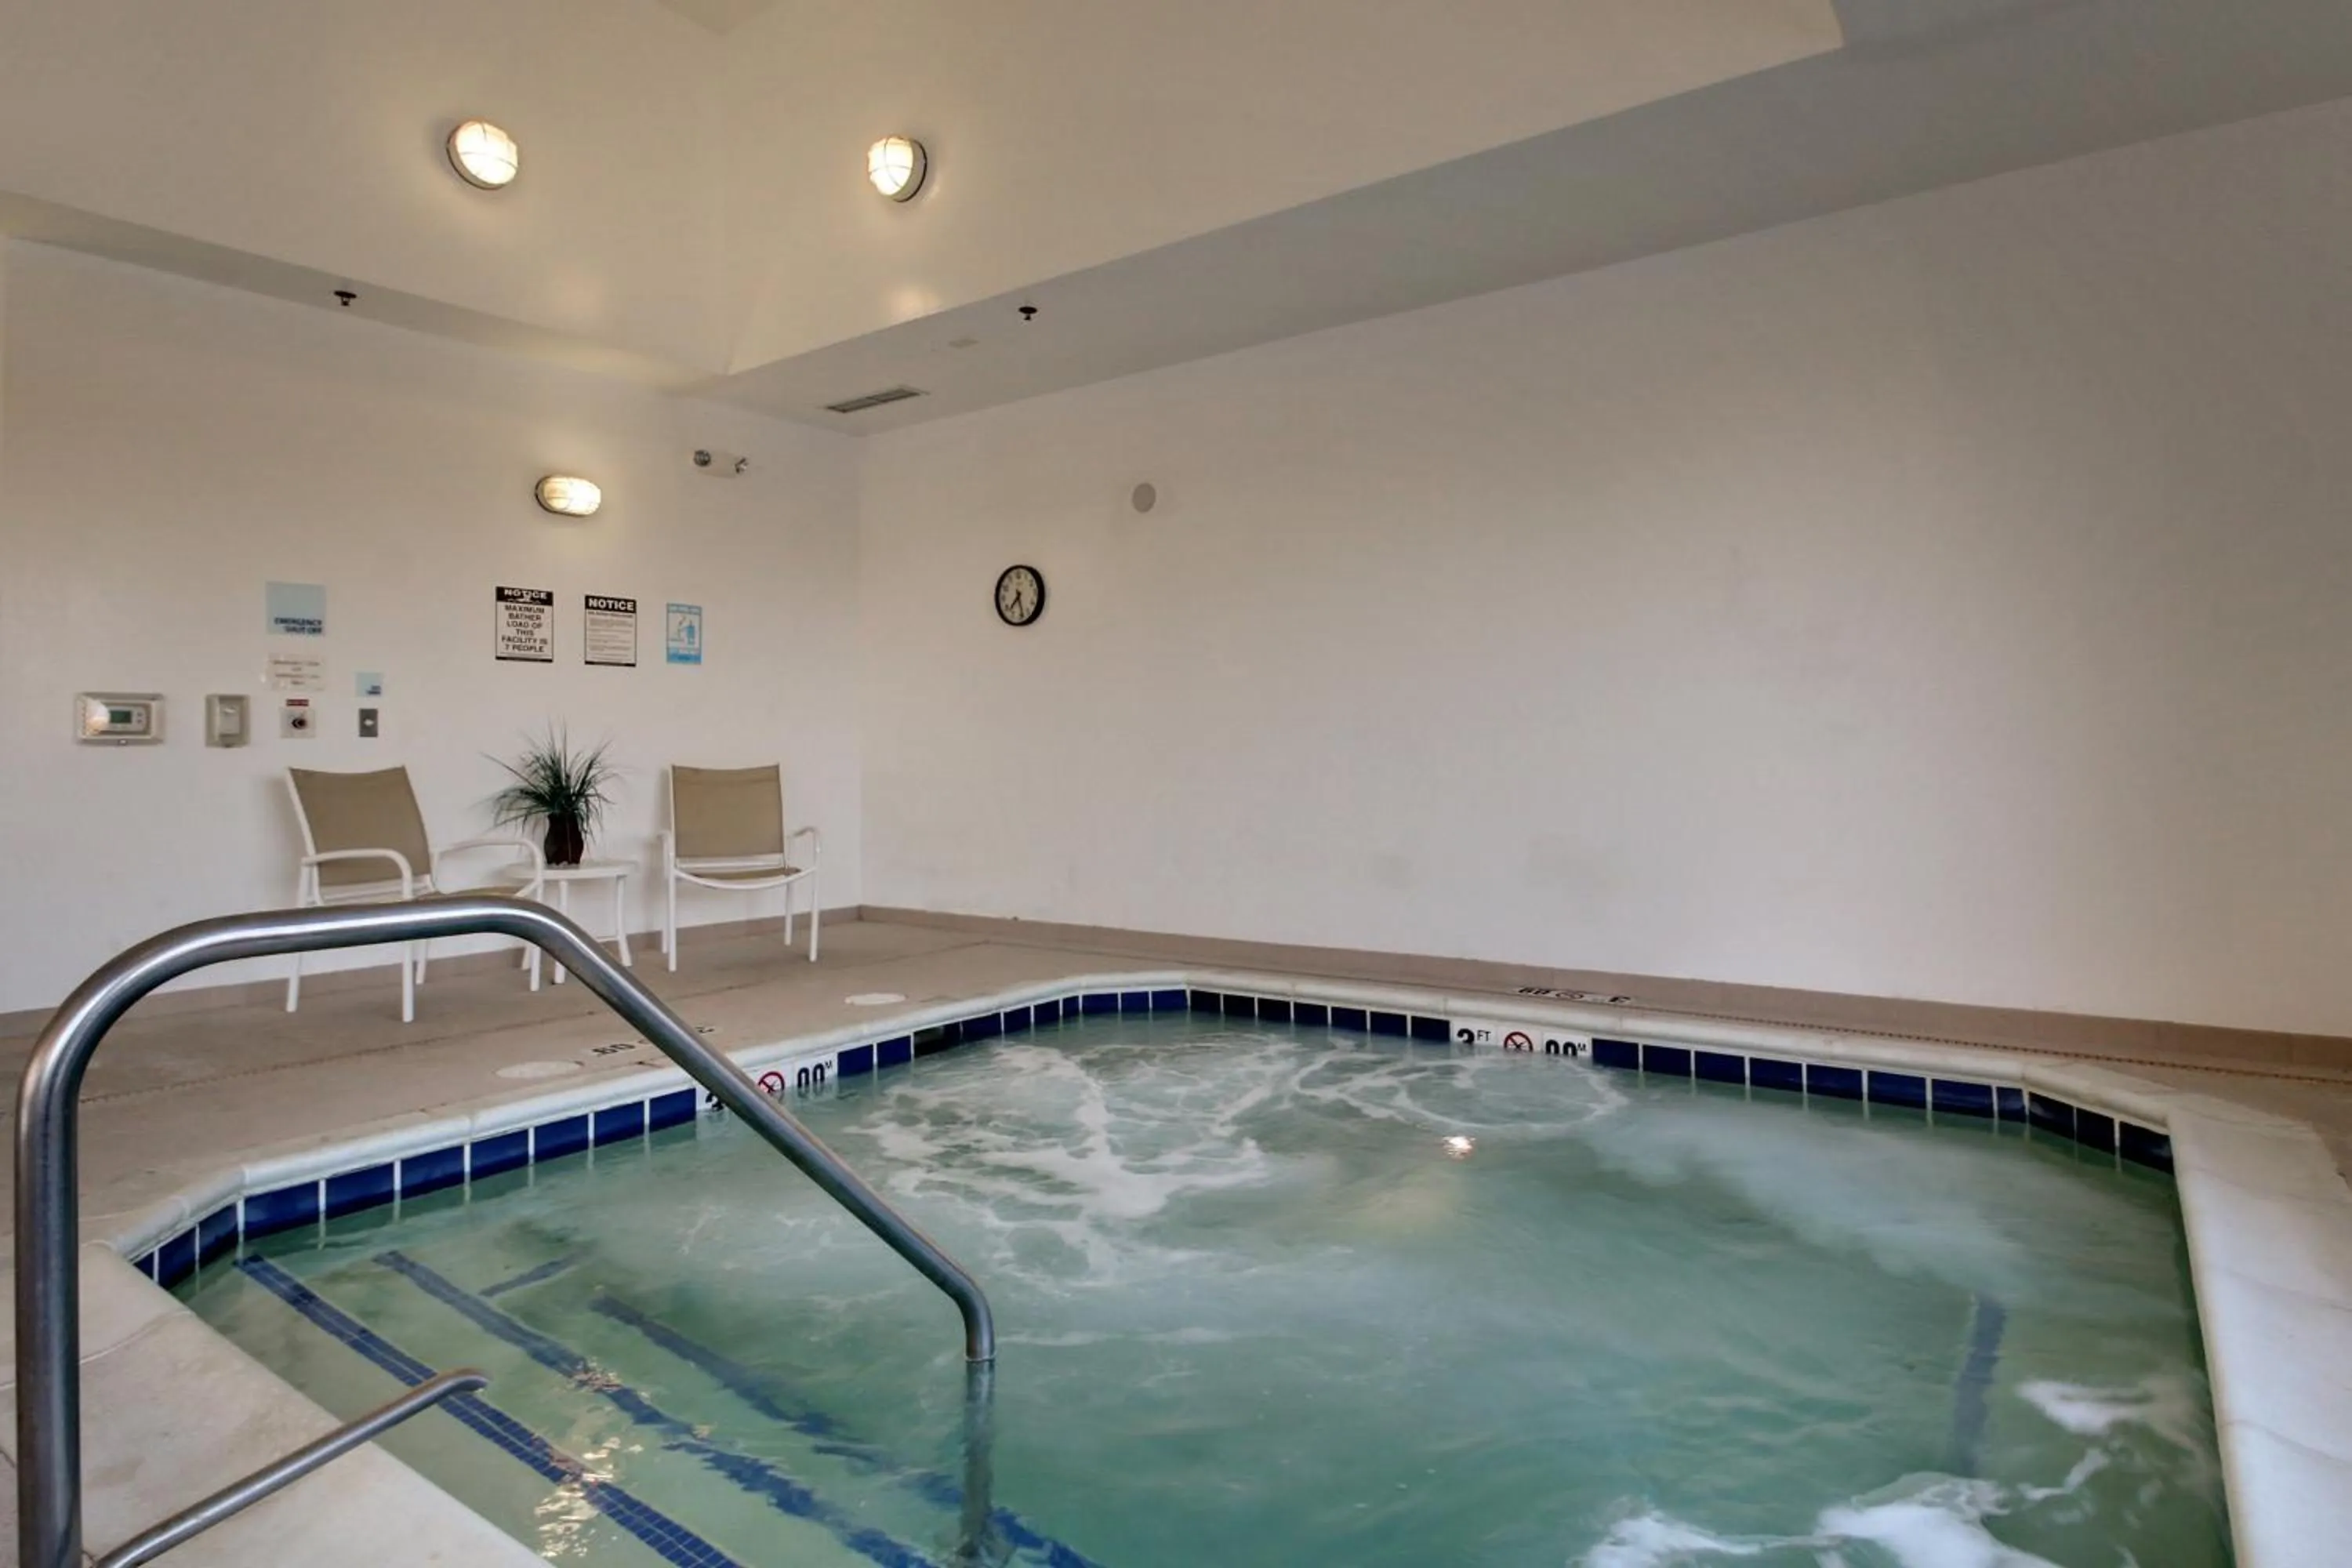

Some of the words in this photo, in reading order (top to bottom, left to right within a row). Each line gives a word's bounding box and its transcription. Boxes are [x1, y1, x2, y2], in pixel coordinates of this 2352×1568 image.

[504, 589, 547, 600] NOTICE
[504, 604, 545, 614] MAXIMUM
[589, 598, 634, 611] NOTICE
[508, 612, 542, 621] BATHER
[502, 634, 537, 644] FACILITY
[512, 644, 545, 653] PEOPLE
